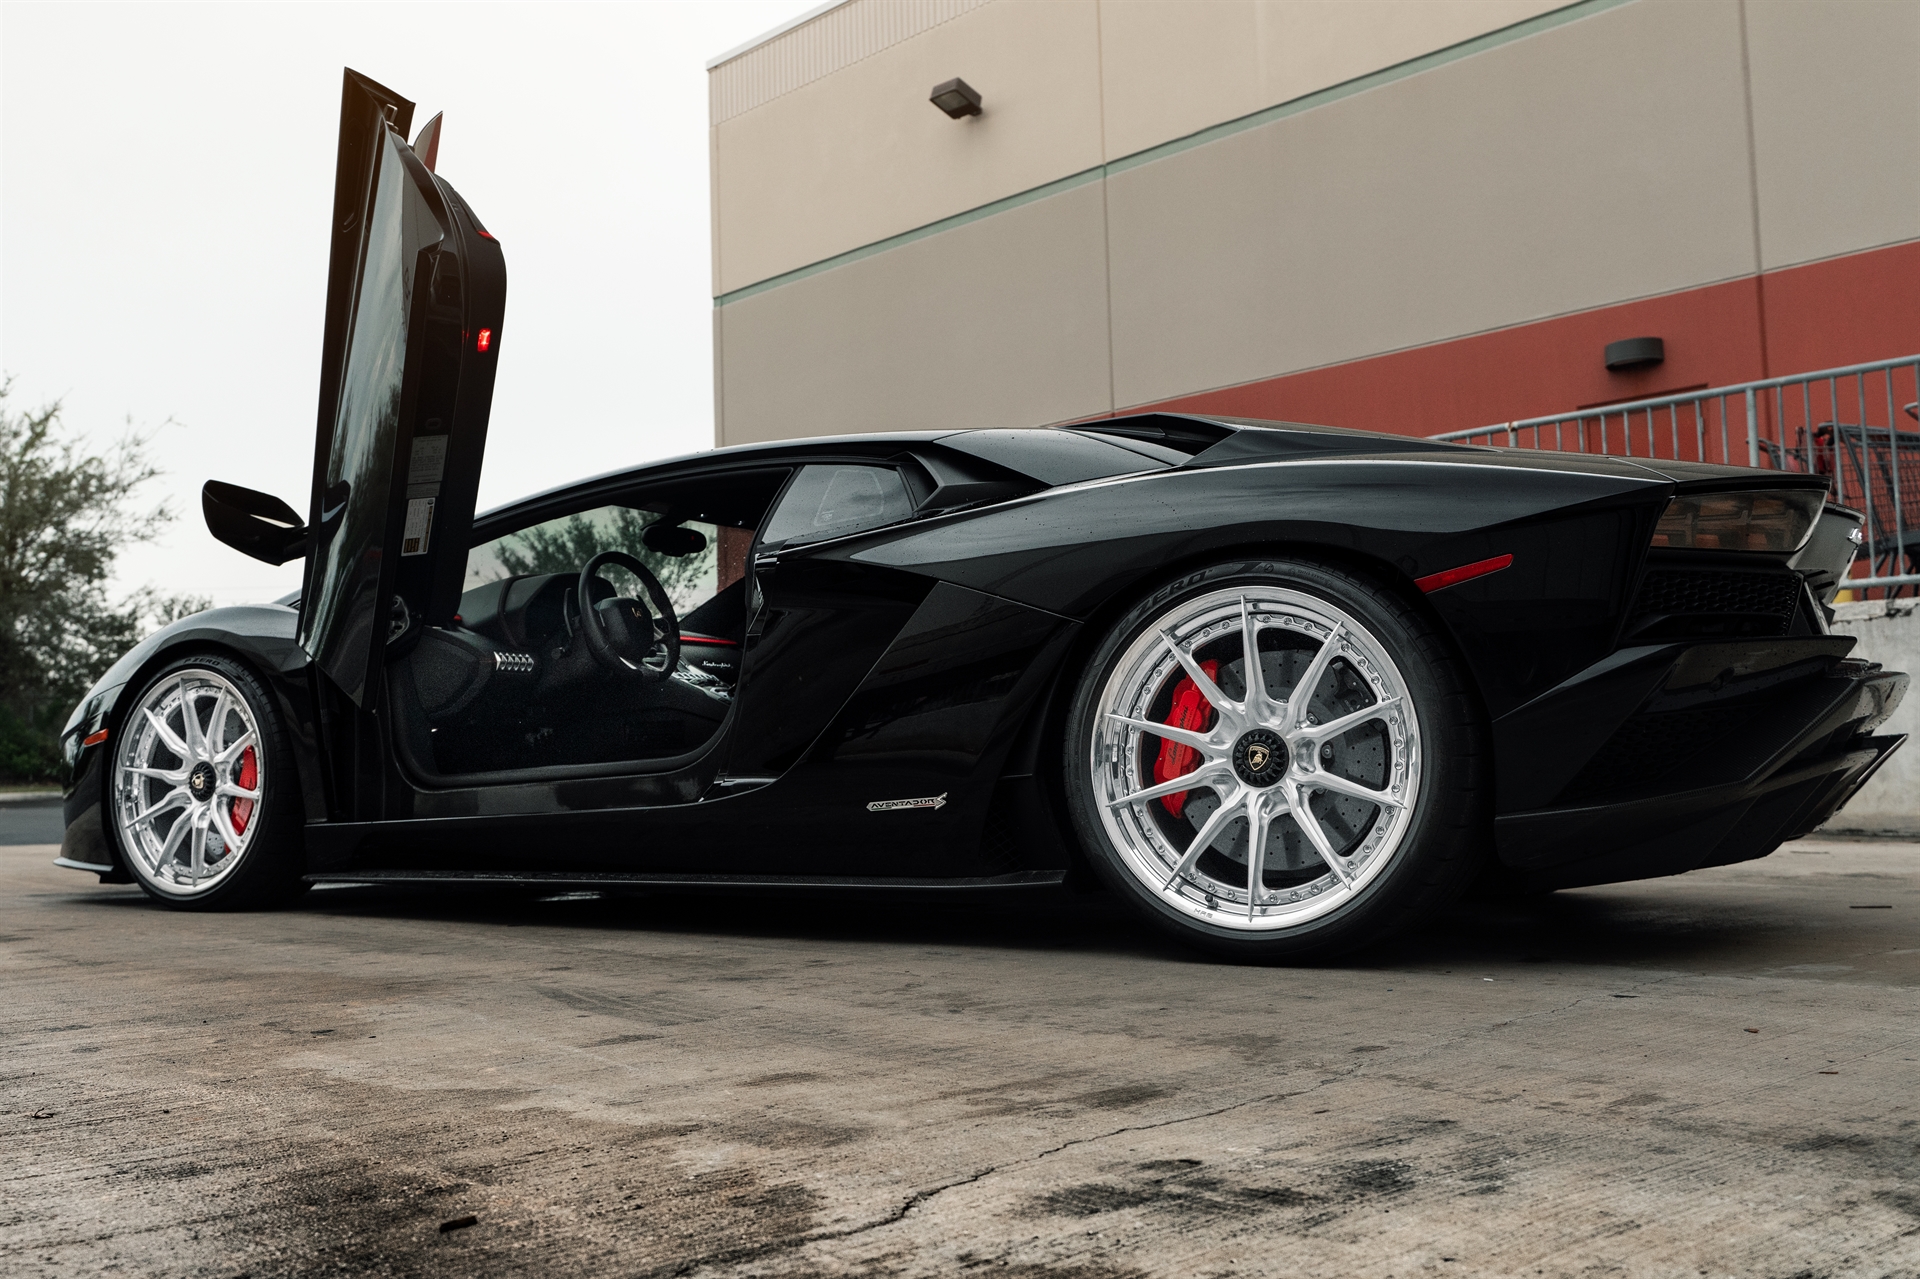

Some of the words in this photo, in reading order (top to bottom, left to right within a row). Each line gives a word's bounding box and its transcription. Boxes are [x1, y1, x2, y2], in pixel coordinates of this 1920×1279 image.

[1118, 617, 1130, 638] P
[1136, 571, 1206, 619] ZERO
[192, 657, 221, 666] ZERO
[871, 798, 935, 809] AVENTADOR
